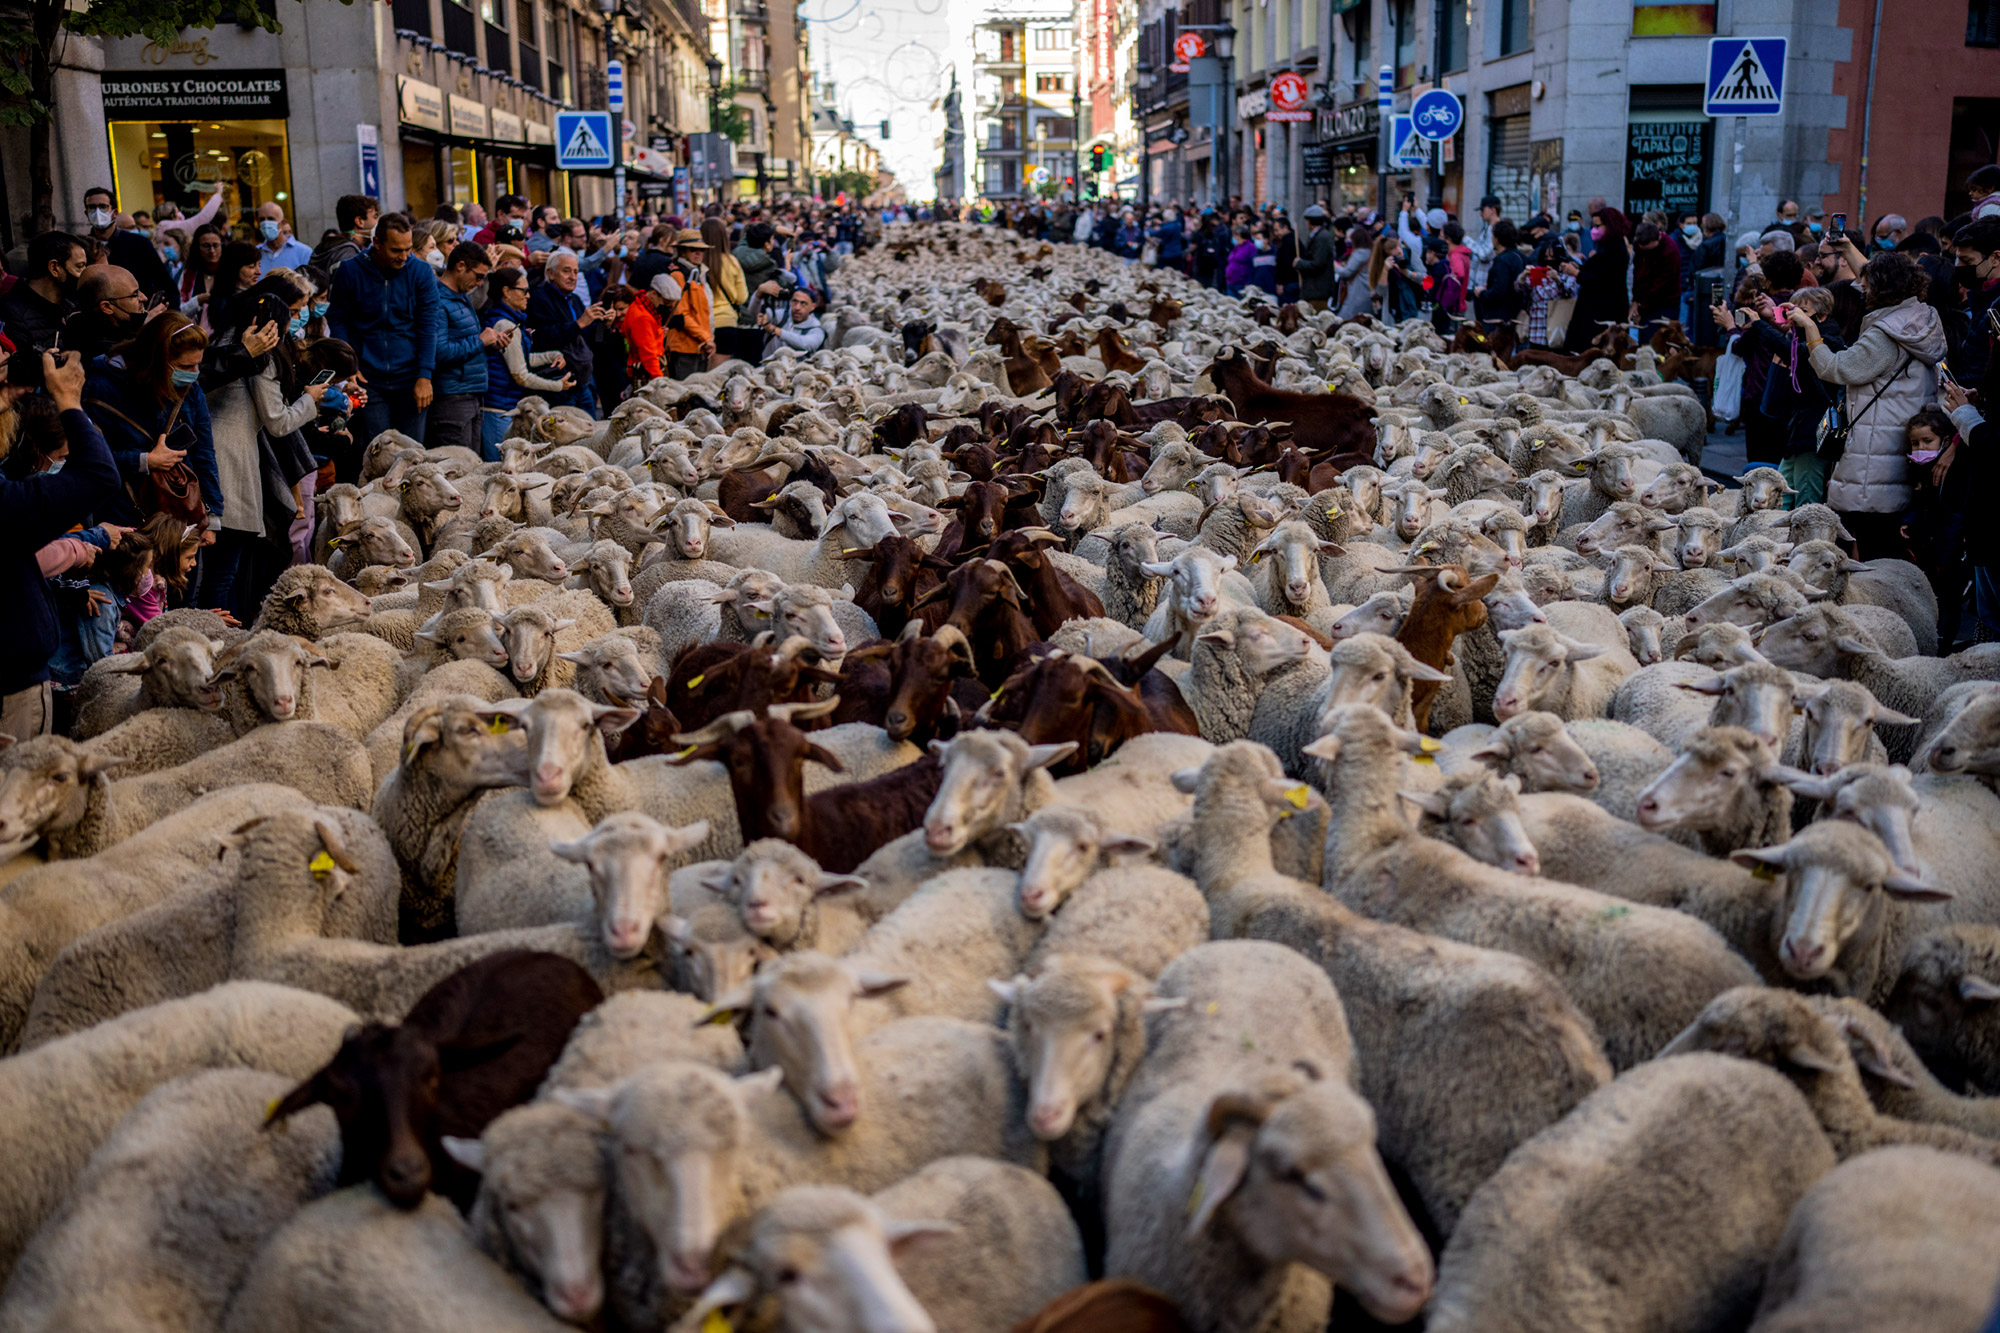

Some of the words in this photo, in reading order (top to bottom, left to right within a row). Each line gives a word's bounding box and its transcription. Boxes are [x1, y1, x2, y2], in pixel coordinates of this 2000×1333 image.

[101, 82, 169, 94] URRONES
[172, 82, 181, 93] Y
[183, 79, 281, 93] CHOCOLATES
[104, 95, 162, 107] AUTÉNTICA
[164, 94, 221, 106] TRADICIÓN
[222, 95, 271, 105] FAMILIAR
[1631, 135, 1671, 154] TAPAS
[1631, 154, 1687, 181] RACIONES
[1629, 199, 1665, 214] TAPAS
